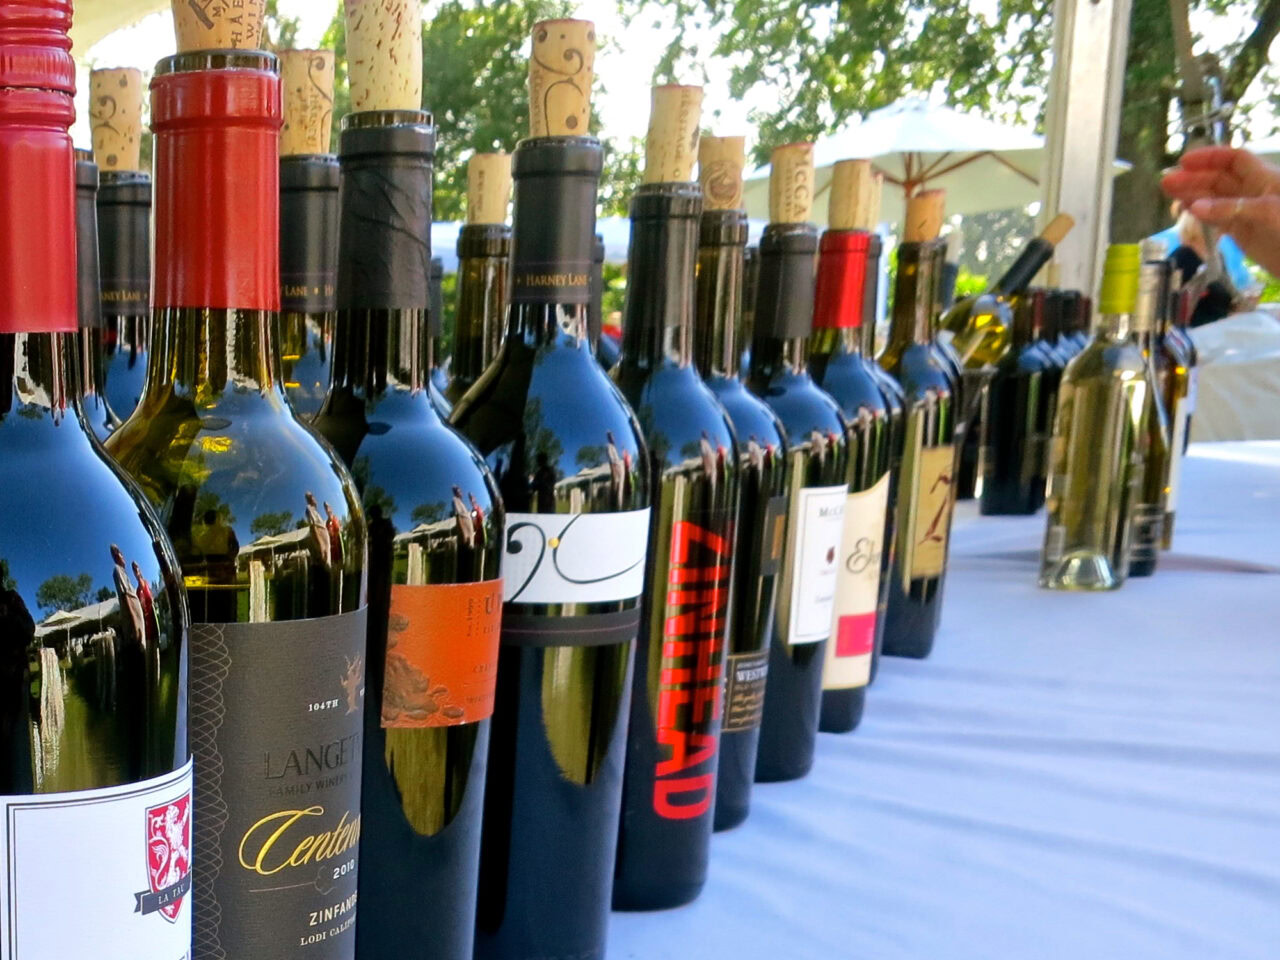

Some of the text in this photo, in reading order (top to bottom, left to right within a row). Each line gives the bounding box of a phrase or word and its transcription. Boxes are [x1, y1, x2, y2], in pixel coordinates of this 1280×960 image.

[526, 273, 567, 287] HARNEY
[284, 284, 308, 297] LANE
[652, 520, 734, 820] ZINHEAD
[308, 698, 339, 712] 104TH
[332, 859, 355, 880] 2010
[157, 893, 169, 905] LA
[299, 930, 327, 947] LODI
